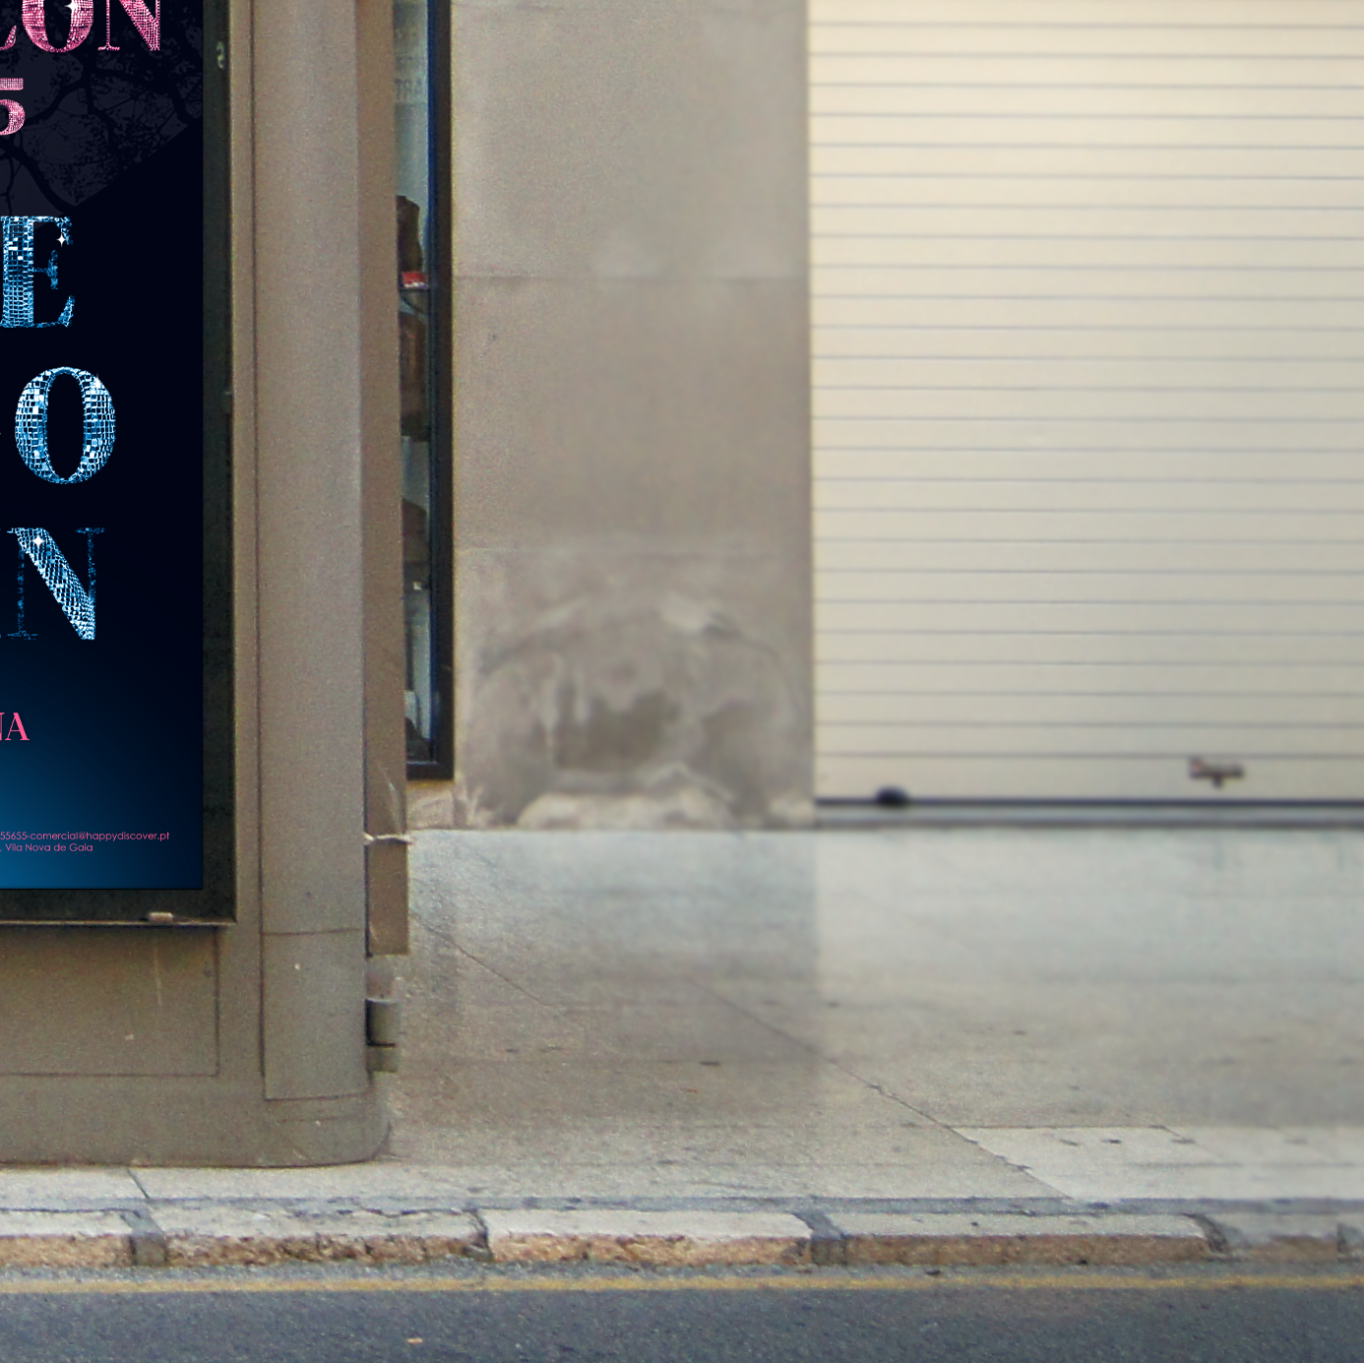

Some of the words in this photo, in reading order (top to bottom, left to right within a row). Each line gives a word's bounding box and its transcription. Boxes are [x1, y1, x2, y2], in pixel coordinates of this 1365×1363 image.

[5, 843, 23, 852] Vila
[25, 843, 51, 852] Nova
[53, 843, 67, 852] de
[69, 843, 94, 852] Gaia
